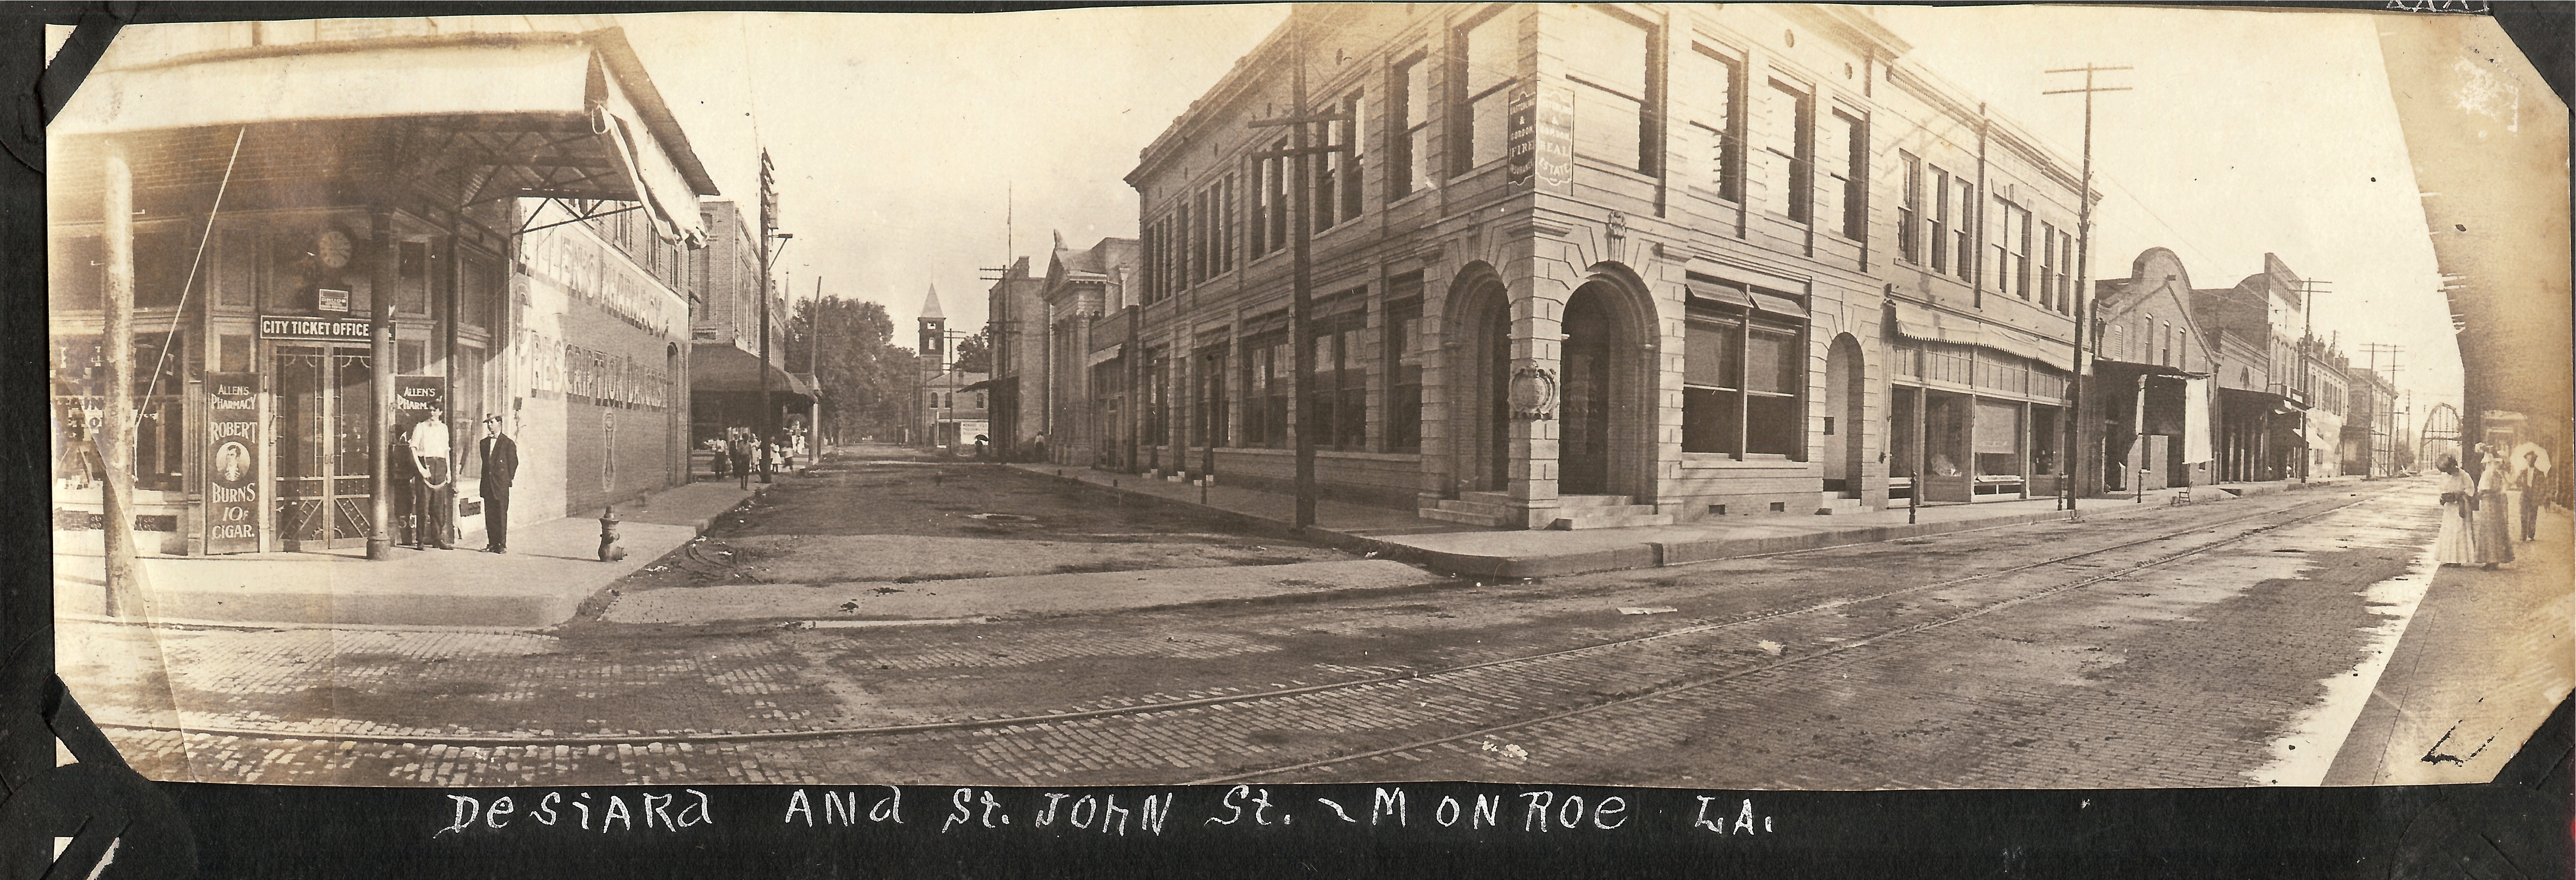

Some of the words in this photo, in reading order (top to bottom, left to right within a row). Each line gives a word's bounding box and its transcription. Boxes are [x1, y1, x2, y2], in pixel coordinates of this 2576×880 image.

[1519, 116, 1525, 125] &
[1551, 116, 1559, 125] &
[1511, 126, 1533, 140] GORDON
[1511, 141, 1534, 157] FIRE
[1539, 141, 1568, 156] REAL
[1539, 157, 1571, 176] ESTATE
[263, 320, 289, 334] CITY
[291, 321, 331, 335] TICKET
[218, 384, 250, 396] ALLEN'S
[403, 386, 435, 397] ALLEN'S
[211, 393, 257, 410] PHARMACY
[397, 393, 443, 410] PHARM
[210, 422, 258, 444] ROBERT
[212, 482, 256, 503] BURNS
[942, 787, 1010, 833] St.
[1204, 785, 1290, 826] St.
